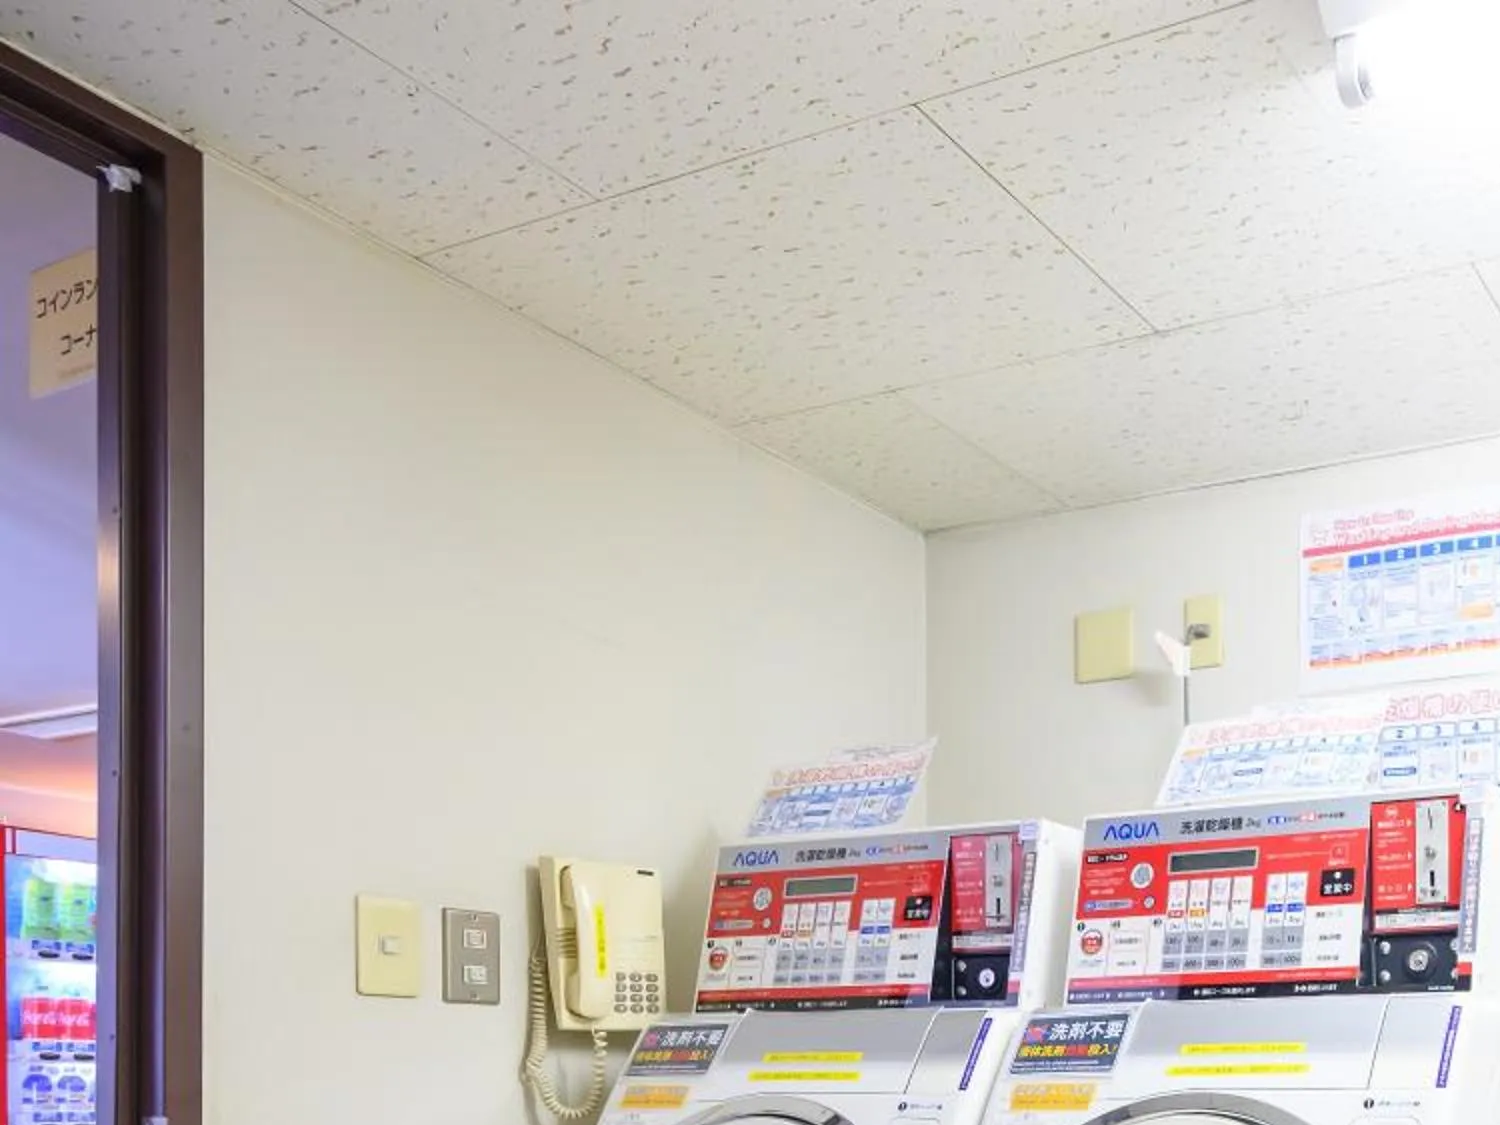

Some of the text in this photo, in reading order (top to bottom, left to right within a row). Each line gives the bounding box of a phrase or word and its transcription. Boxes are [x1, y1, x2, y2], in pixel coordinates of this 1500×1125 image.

[1103, 822, 1160, 842] AQUA
[732, 849, 779, 866] AQUA
[1050, 1020, 1125, 1040] 洗剤不要
